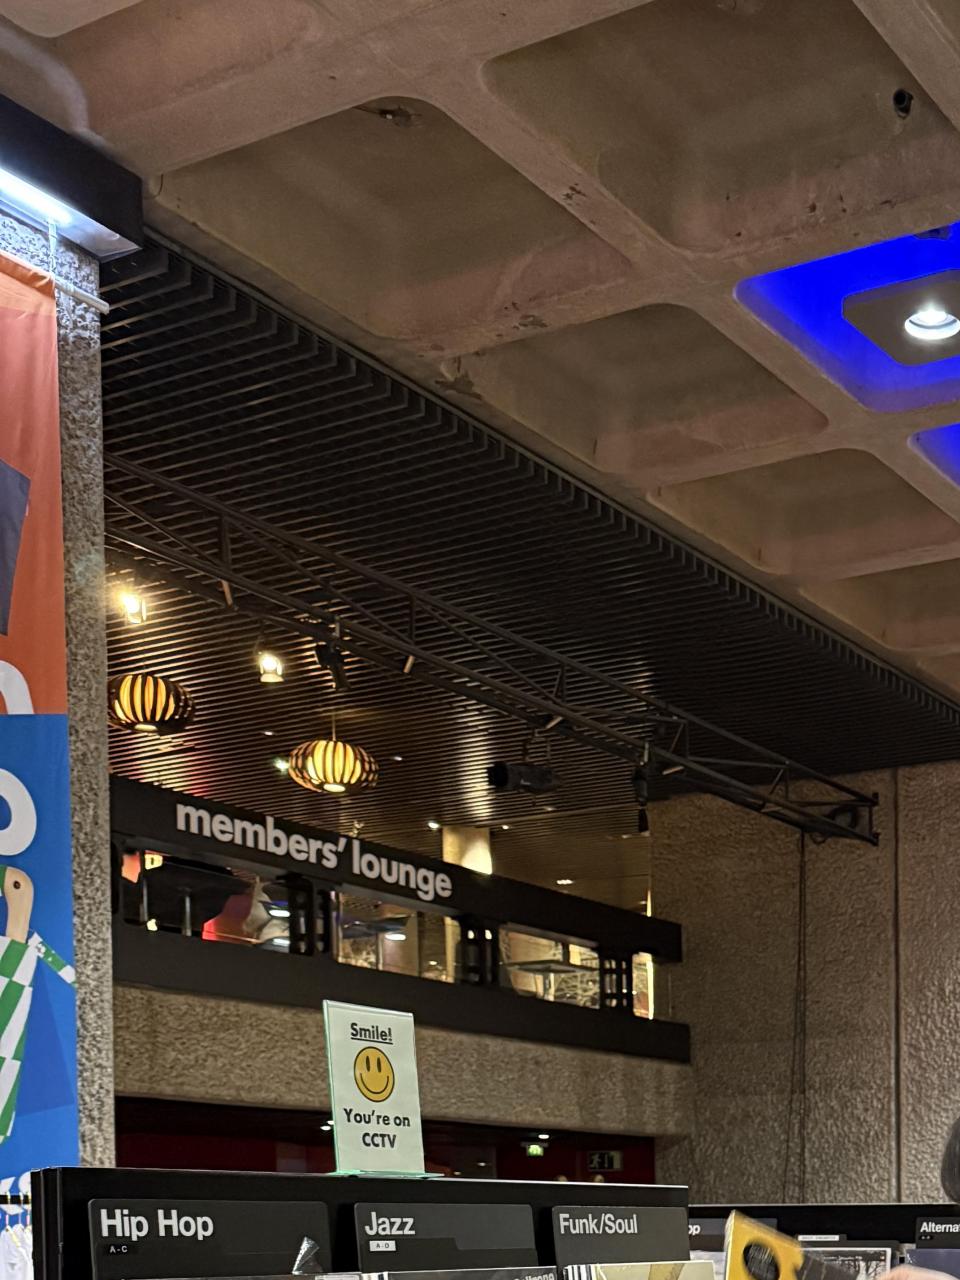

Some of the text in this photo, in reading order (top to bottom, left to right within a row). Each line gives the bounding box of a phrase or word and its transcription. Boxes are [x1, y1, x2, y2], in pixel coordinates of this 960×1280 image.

[176, 803, 453, 901] members' lounge
[350, 1022, 393, 1042] Smile!
[343, 1108, 411, 1127] You're on
[362, 1133, 397, 1148] CCTV
[100, 1208, 214, 1241] Hip Hop
[364, 1211, 415, 1236] Jazz
[559, 1213, 638, 1235] Funk/Soul
